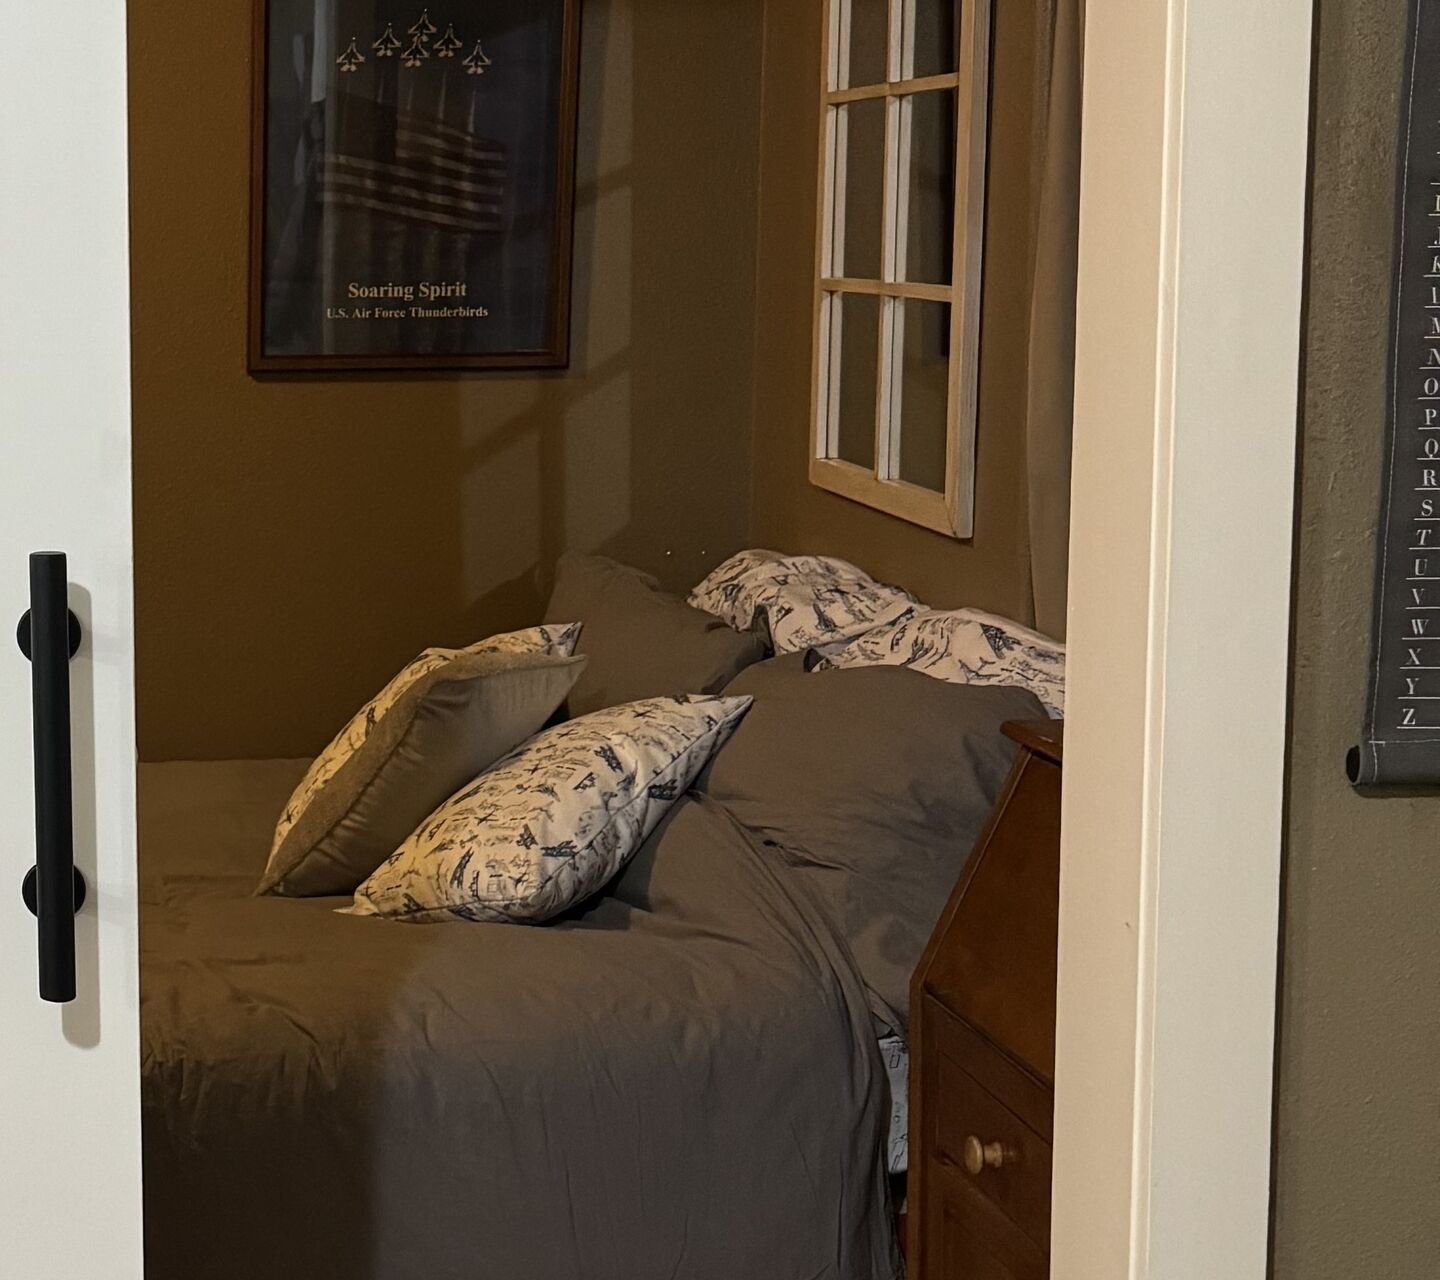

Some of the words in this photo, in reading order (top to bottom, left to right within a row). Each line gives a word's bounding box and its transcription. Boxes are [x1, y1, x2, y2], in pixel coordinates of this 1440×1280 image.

[348, 282, 414, 301] Soaring
[419, 281, 467, 300] Spirit
[327, 308, 348, 319] U.S.
[352, 308, 372, 318] Air
[375, 308, 406, 318] Force
[410, 307, 488, 318] Thunderbirds
[1423, 377, 1439, 396] O
[1424, 408, 1437, 426] P
[1424, 438, 1439, 458] Q
[1422, 469, 1437, 487] R
[1421, 498, 1433, 517] S
[1416, 529, 1431, 546] T
[1414, 558, 1428, 576] U
[1411, 588, 1425, 605] V
[1411, 618, 1430, 635] W
[1405, 648, 1422, 665] X
[1405, 677, 1420, 695] Y
[1402, 708, 1416, 726] Z
